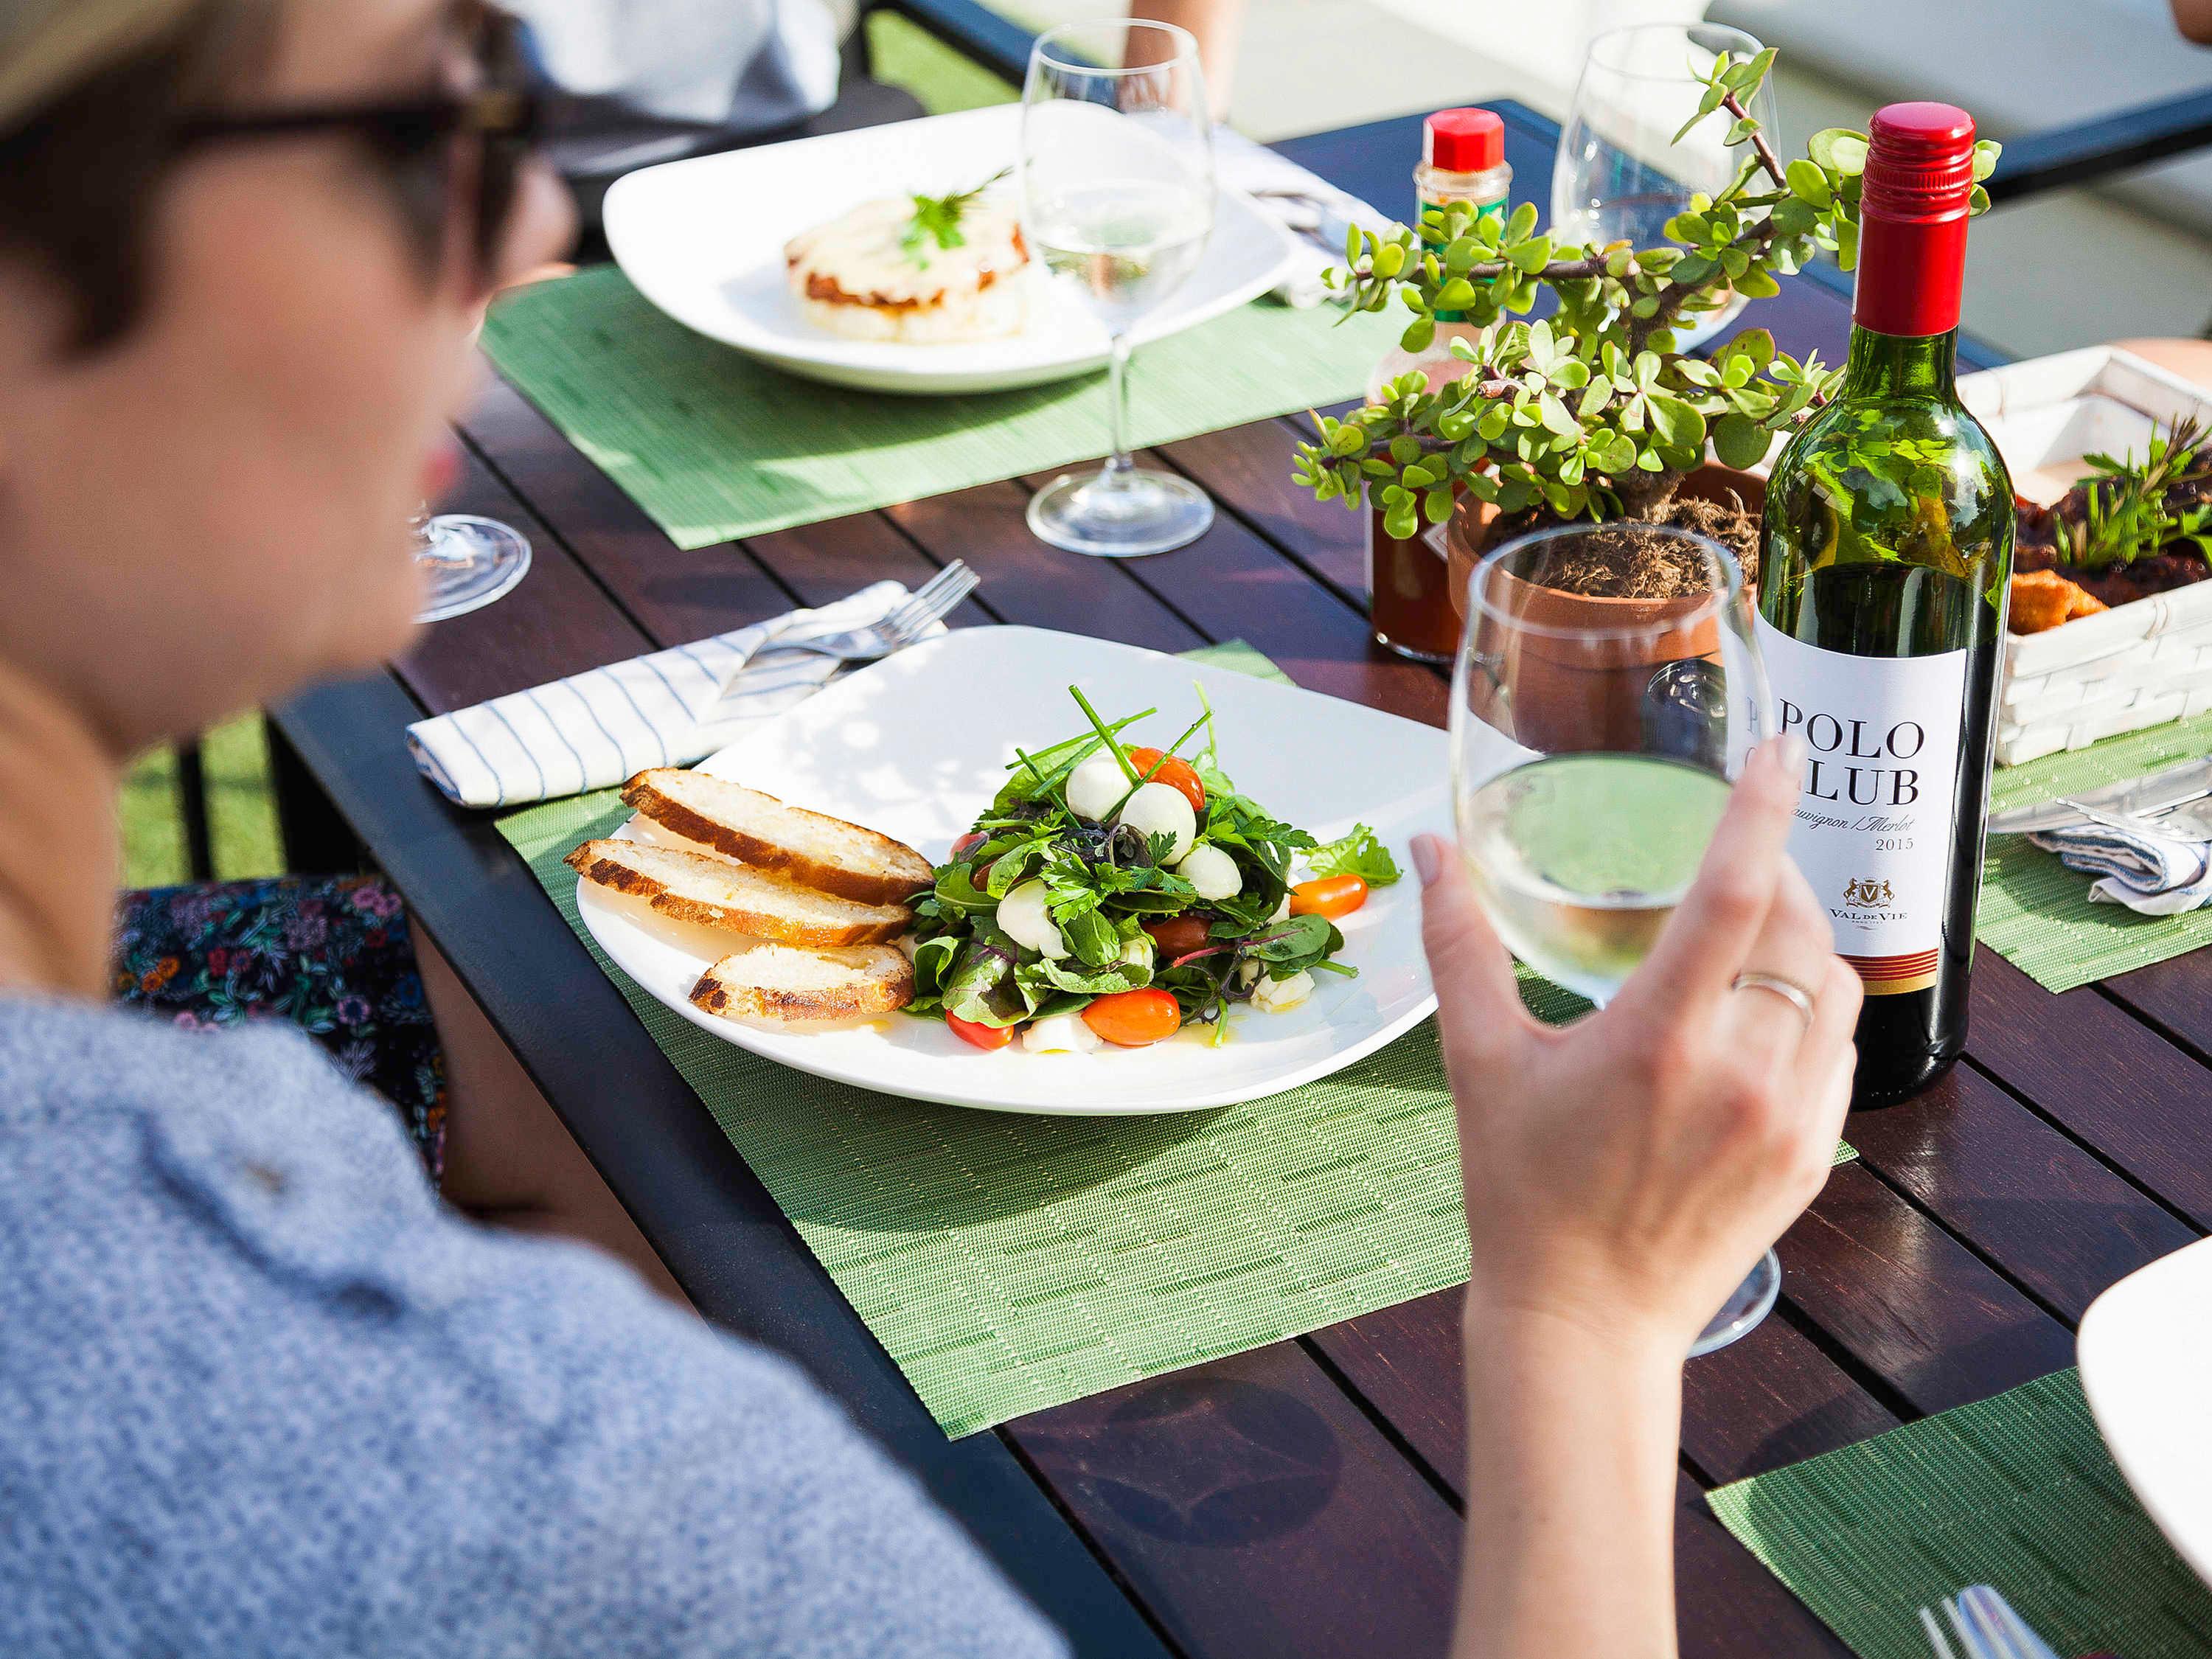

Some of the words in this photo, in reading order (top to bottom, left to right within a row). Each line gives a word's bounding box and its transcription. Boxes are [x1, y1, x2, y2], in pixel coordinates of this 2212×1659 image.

[1778, 698, 1925, 759] POLO
[1799, 758, 1919, 806] LUB
[1791, 801, 1848, 830] auvignon
[1875, 838, 1914, 851] 2015
